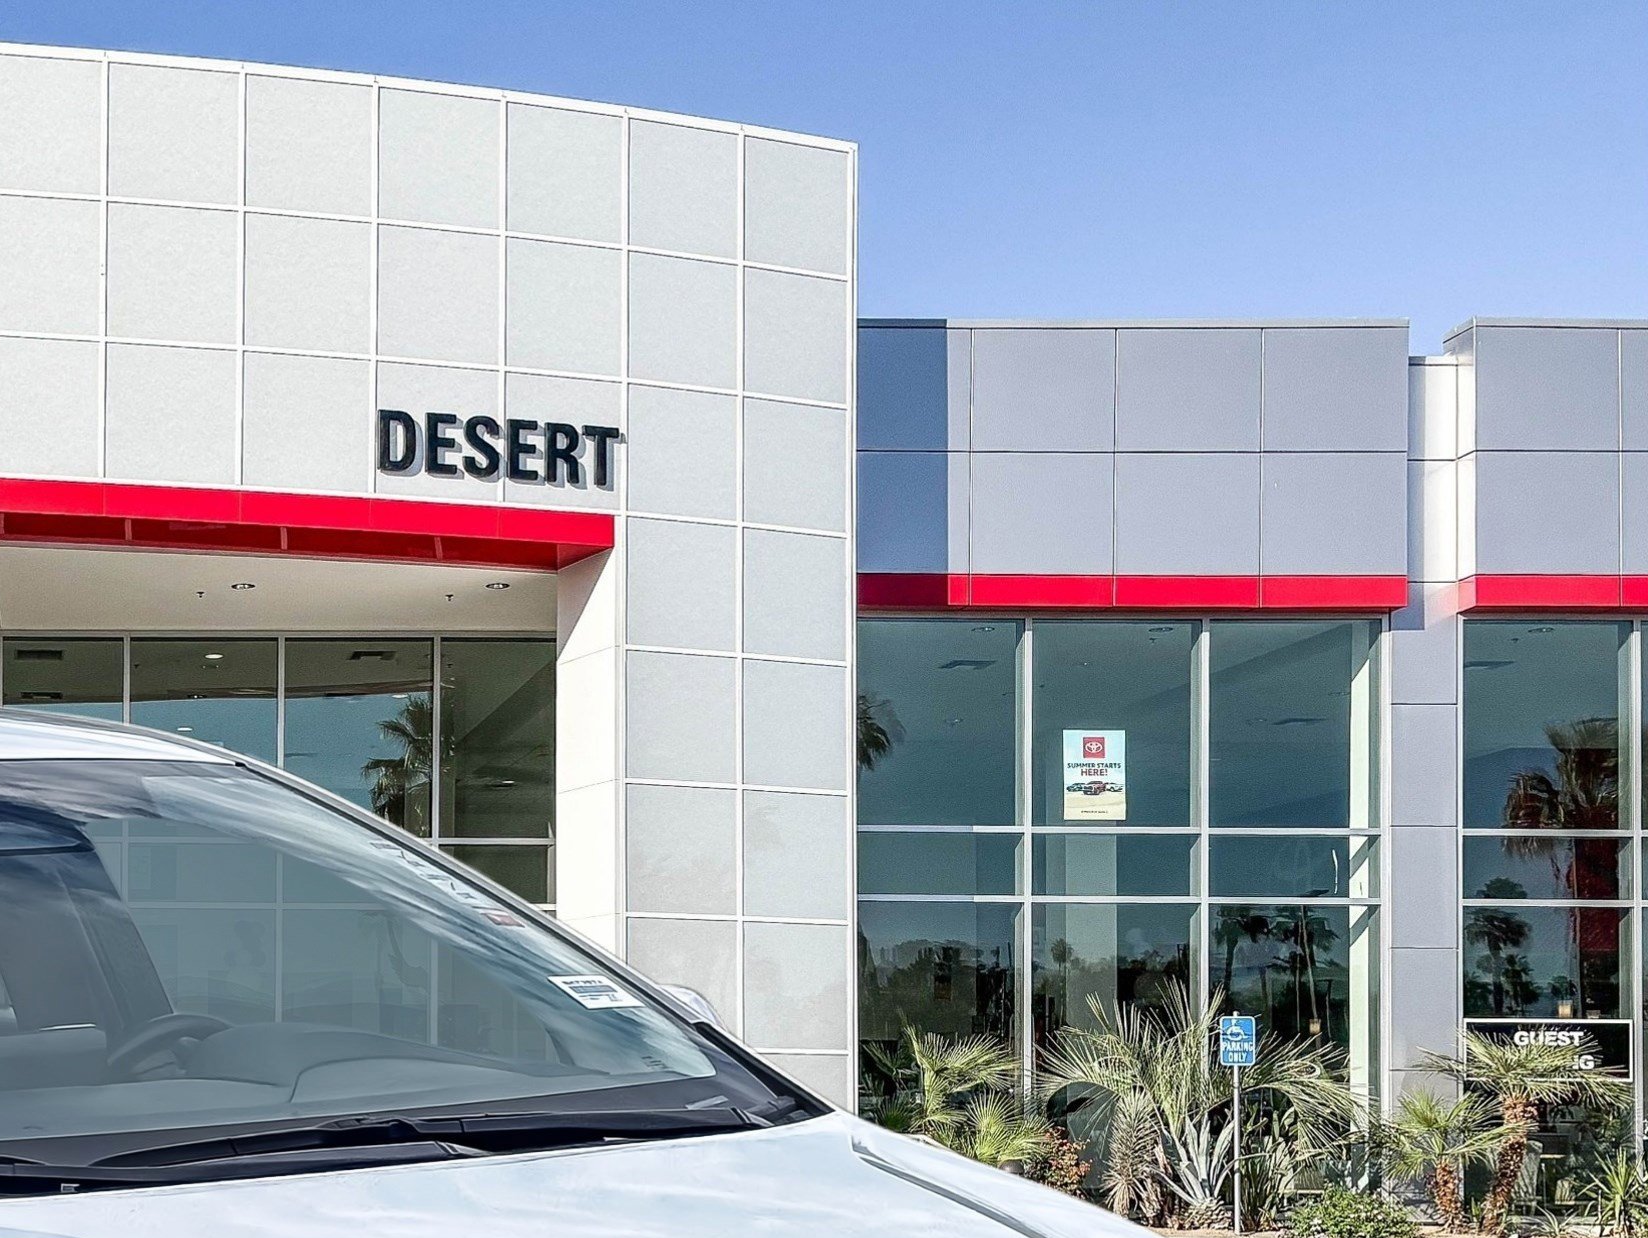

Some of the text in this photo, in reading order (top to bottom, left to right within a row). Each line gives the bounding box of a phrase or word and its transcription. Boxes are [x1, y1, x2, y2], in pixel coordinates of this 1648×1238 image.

[377, 409, 620, 486] DESERT
[1080, 768, 1108, 776] HERE!
[1513, 1031, 1584, 1047] GUEST
[1222, 1041, 1254, 1052] PARKING
[1228, 1052, 1248, 1062] ONLY
